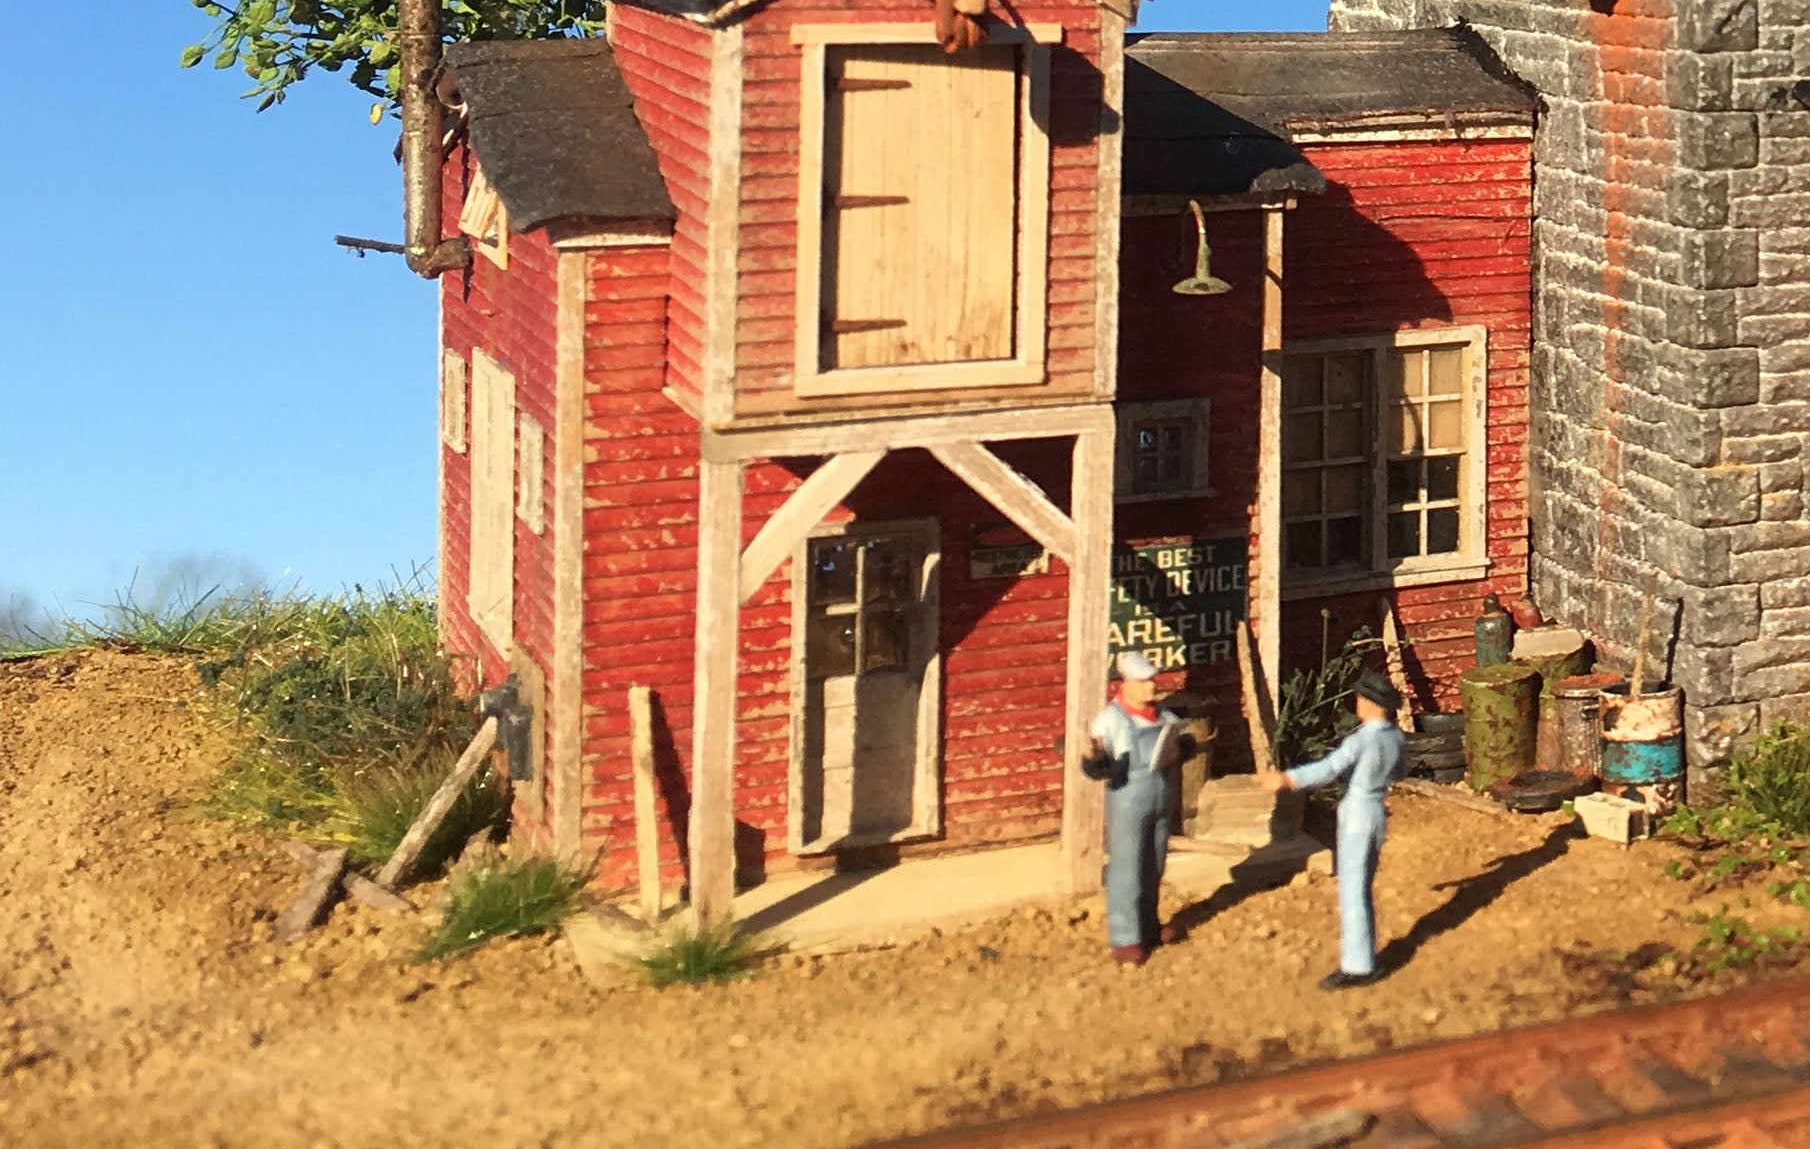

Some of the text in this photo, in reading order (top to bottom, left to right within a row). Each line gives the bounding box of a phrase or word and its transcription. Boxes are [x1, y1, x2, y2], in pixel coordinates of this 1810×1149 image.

[1157, 545, 1216, 569] BEST
[1166, 564, 1245, 598] DEVICE
[1109, 610, 1236, 647] AREFUL
